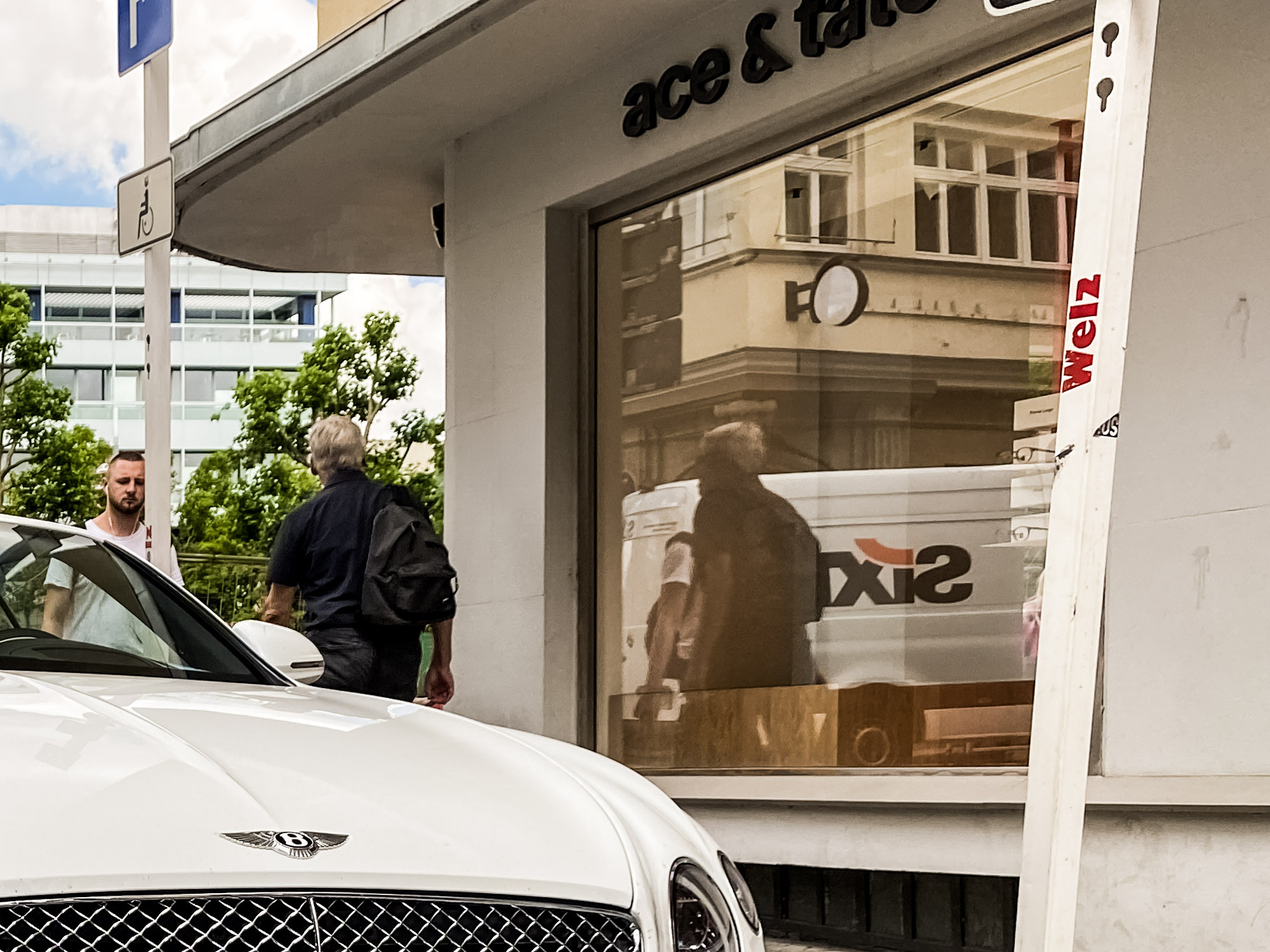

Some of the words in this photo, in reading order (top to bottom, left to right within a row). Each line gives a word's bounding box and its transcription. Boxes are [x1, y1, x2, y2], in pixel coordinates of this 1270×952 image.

[622, 48, 730, 138] ace
[741, 12, 793, 84] &
[1061, 273, 1102, 394] Welz
